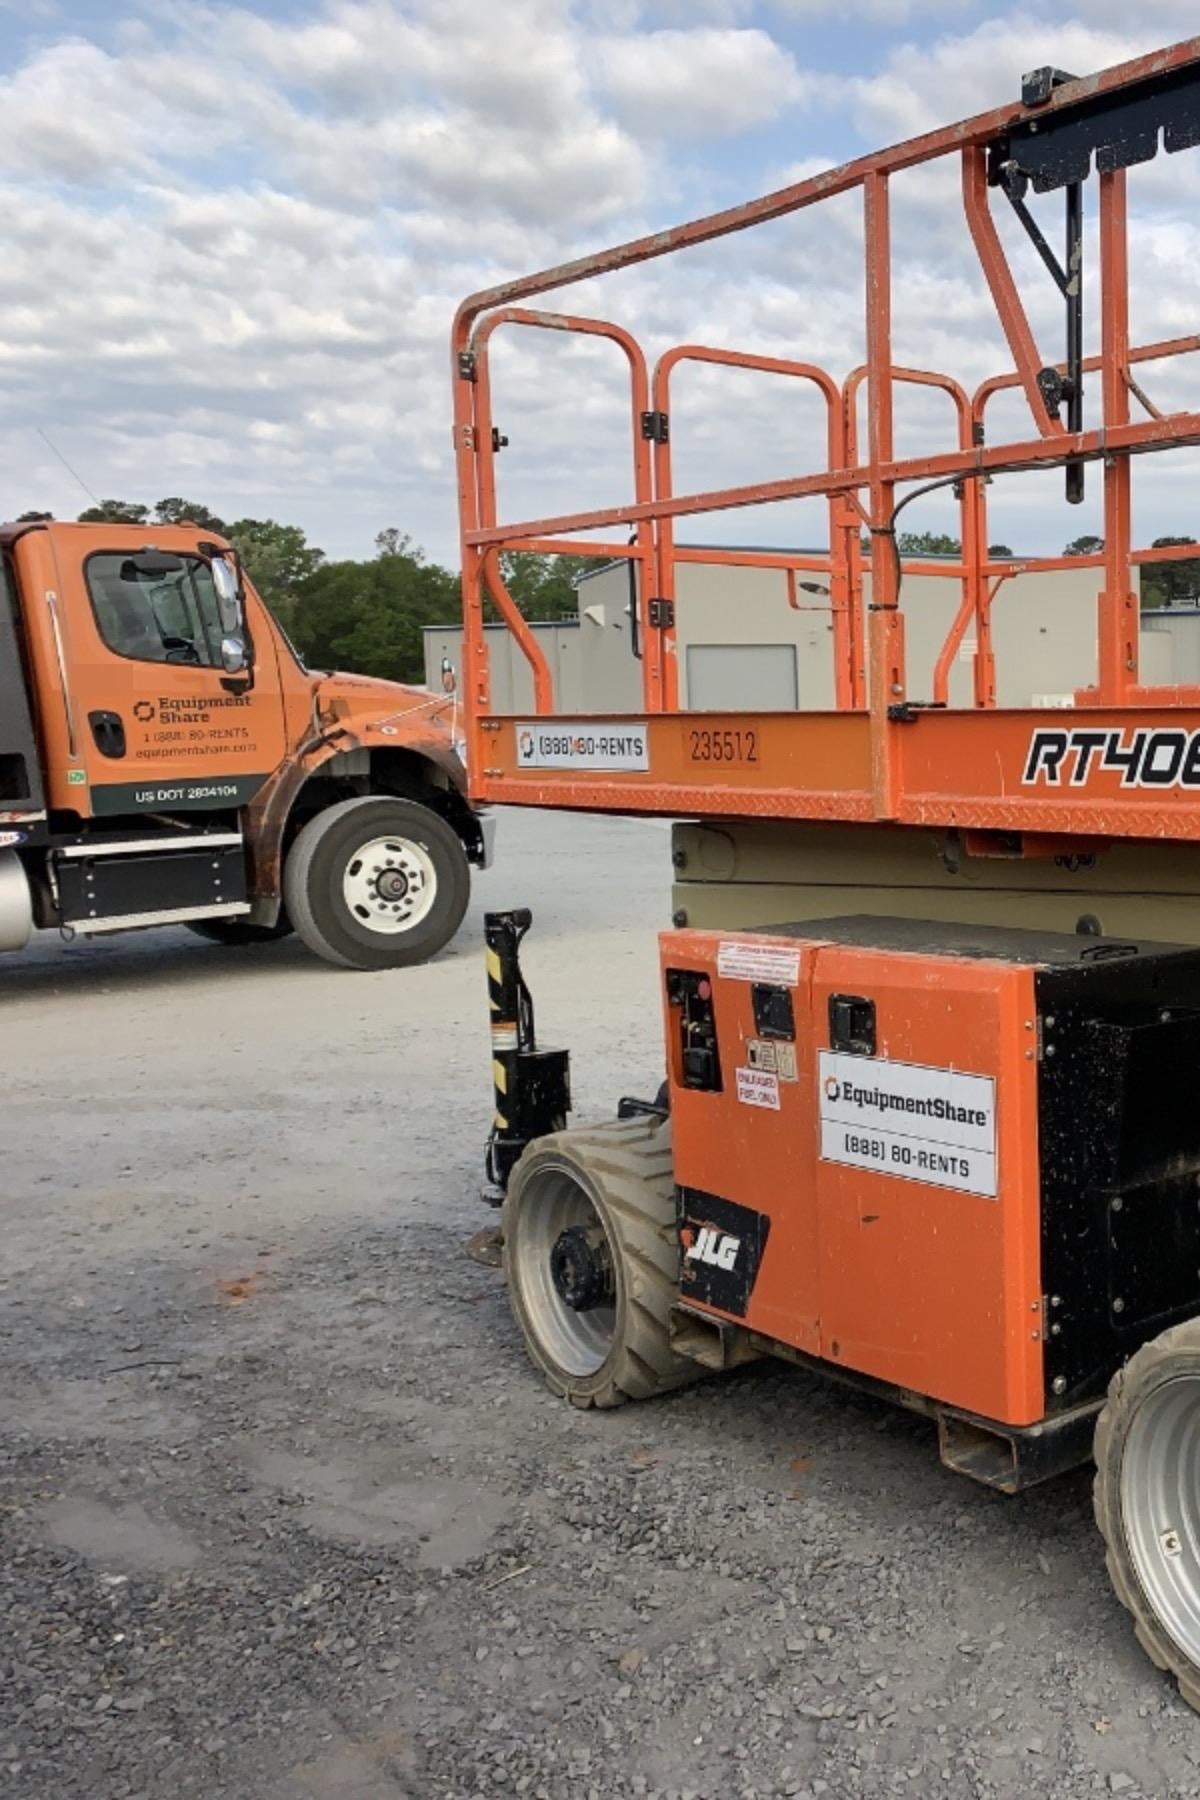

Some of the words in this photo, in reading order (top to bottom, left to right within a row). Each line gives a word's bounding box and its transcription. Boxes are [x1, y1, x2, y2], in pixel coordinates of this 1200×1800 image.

[158, 695, 252, 711] Equipment
[159, 711, 210, 724] Share
[144, 733, 150, 742] 1
[690, 730, 758, 763] 235512
[135, 791, 155, 803] US
[157, 788, 185, 801] DOT
[842, 1081, 987, 1127] EquipmentShare
[891, 1144, 970, 1178] 80-RENTS
[686, 1227, 741, 1271] JLG
